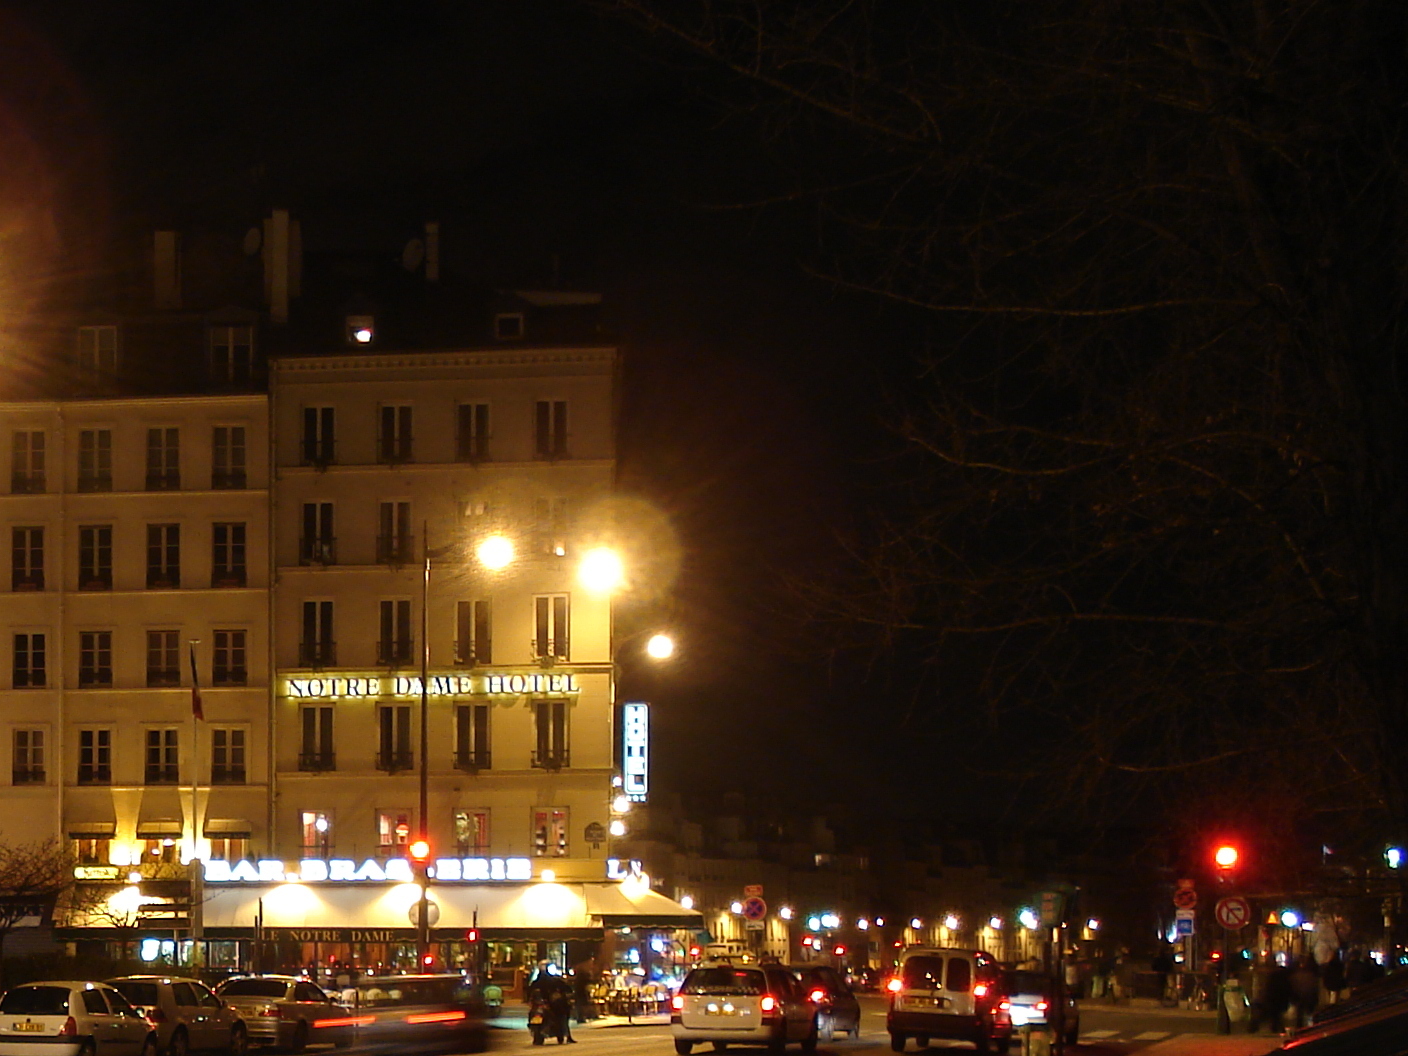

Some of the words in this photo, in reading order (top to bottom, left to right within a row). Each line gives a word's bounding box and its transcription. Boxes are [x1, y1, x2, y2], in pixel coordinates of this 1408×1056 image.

[289, 677, 380, 698] NOTRE
[394, 675, 472, 695] DAME
[487, 673, 579, 694] HOTEL
[627, 705, 645, 791] HOTEL
[205, 859, 286, 881] BAR
[300, 858, 531, 881] BRASERIE
[261, 930, 280, 941] LE
[290, 930, 342, 941] NOTRE
[352, 930, 394, 942] DAME
